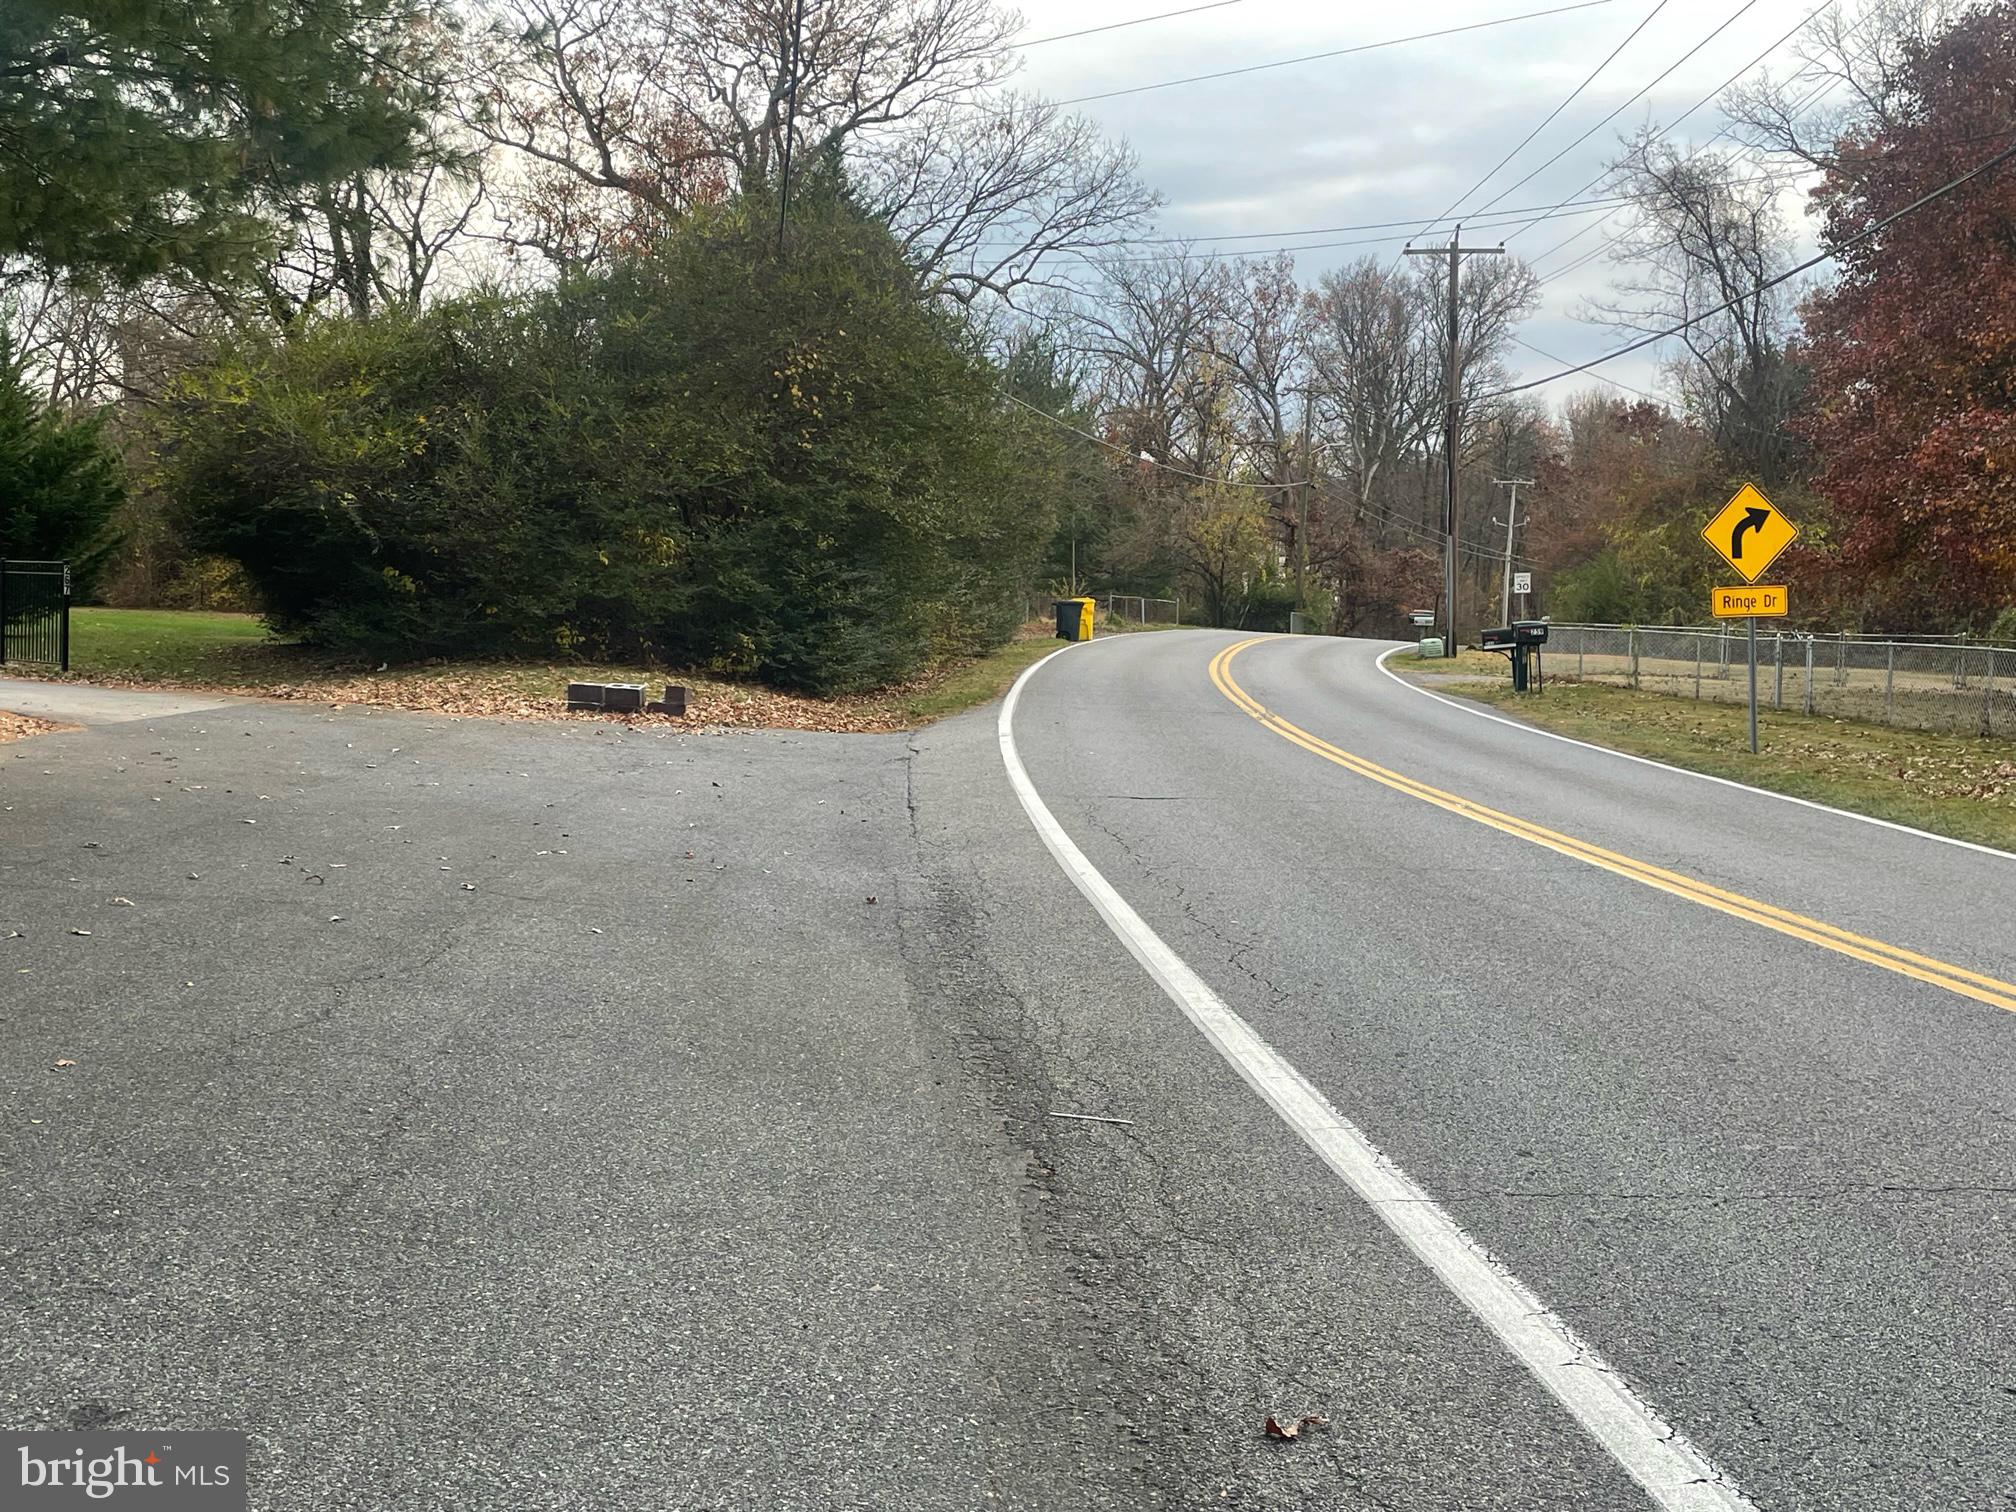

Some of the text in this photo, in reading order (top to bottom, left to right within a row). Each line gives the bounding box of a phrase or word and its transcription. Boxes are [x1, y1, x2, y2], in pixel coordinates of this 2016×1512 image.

[1516, 582, 1530, 591] 30
[1723, 594, 1777, 612] Ringe Dr
